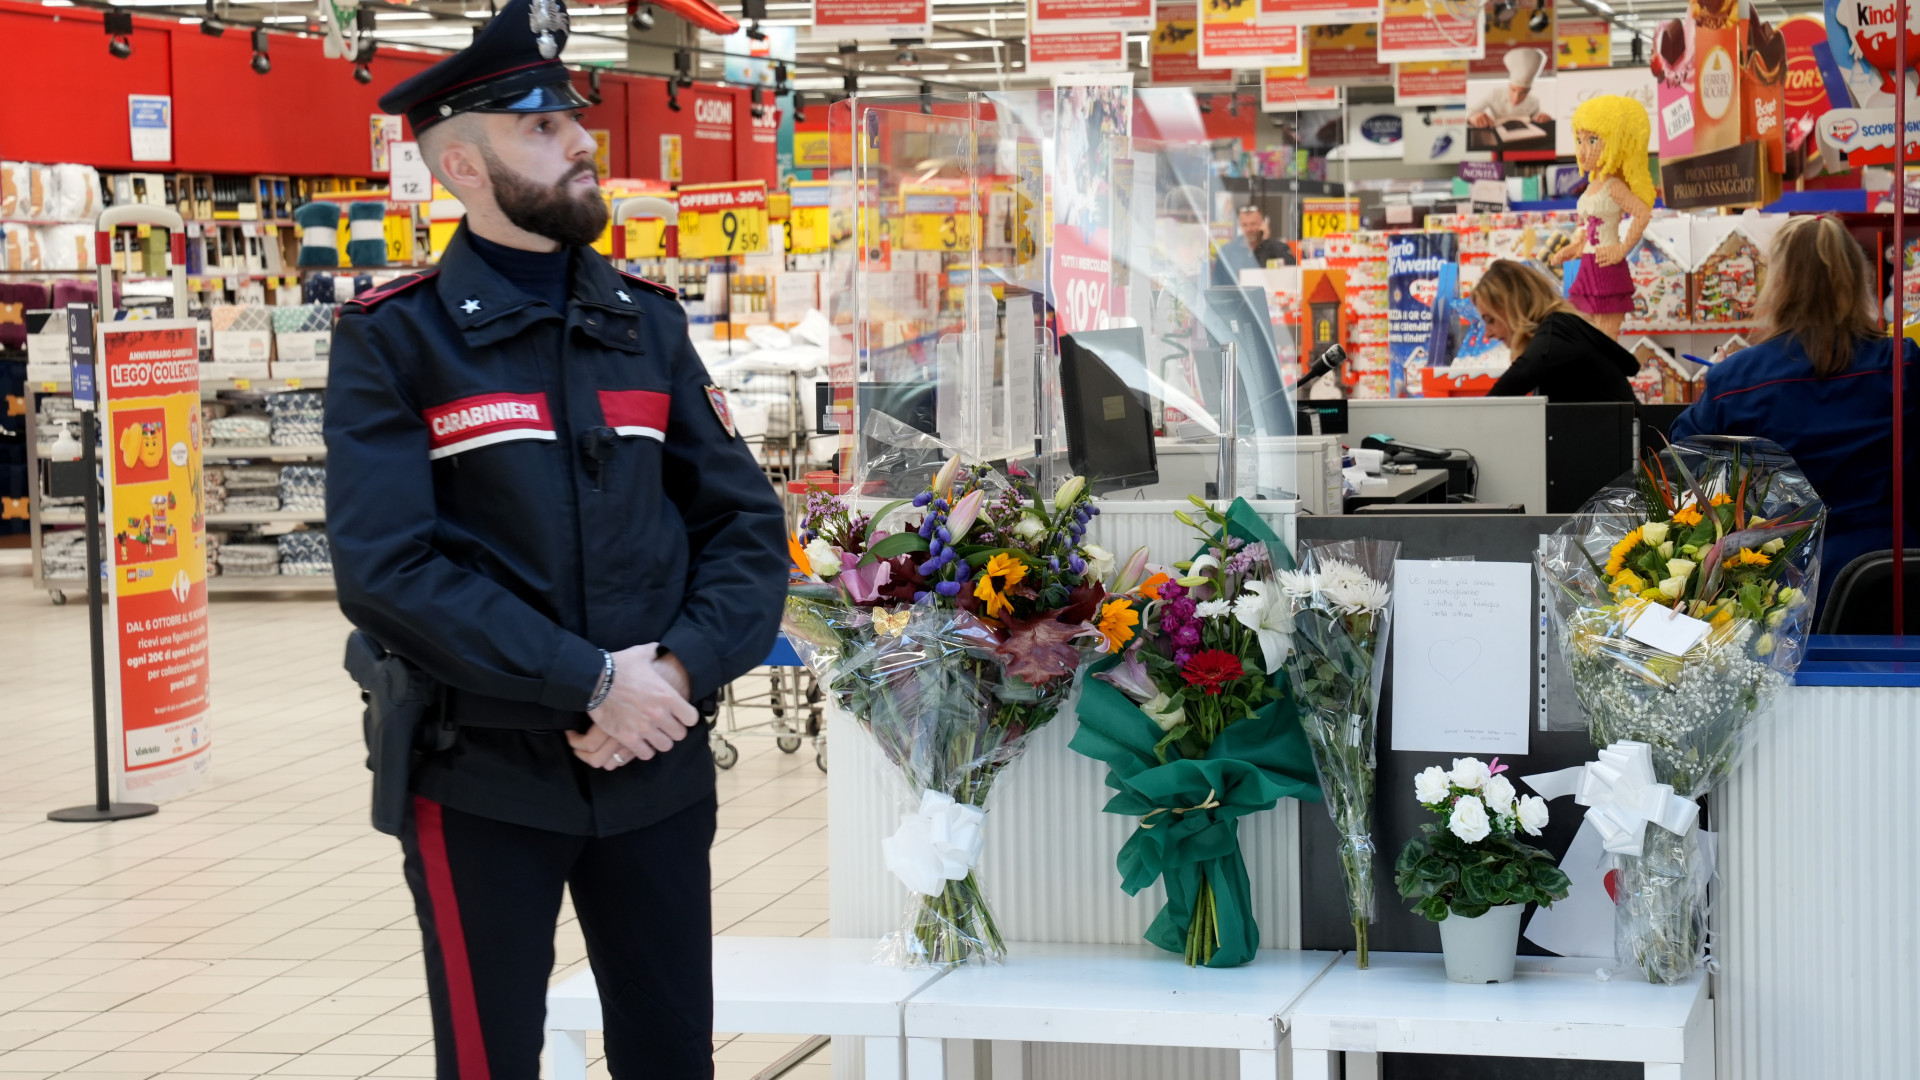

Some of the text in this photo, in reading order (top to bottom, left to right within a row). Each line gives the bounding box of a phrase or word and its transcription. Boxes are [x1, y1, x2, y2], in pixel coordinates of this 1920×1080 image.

[1857, 2, 1912, 26] kindr
[1703, 72, 1730, 85] FERRERO
[1703, 84, 1730, 98] ROCHER
[1674, 177, 1755, 199] PRIMO ASSAGGIO?
[680, 190, 765, 207] OFFERTA -20%
[722, 212, 737, 251] 9
[112, 364, 149, 385] LEGO
[432, 401, 540, 436] CARABINIERI
[126, 621, 144, 634] DAL
[145, 620, 151, 631] 6
[138, 636, 158, 649] ricevi
[160, 635, 172, 646] una
[127, 653, 146, 668] ogni
[148, 670, 160, 682] per
